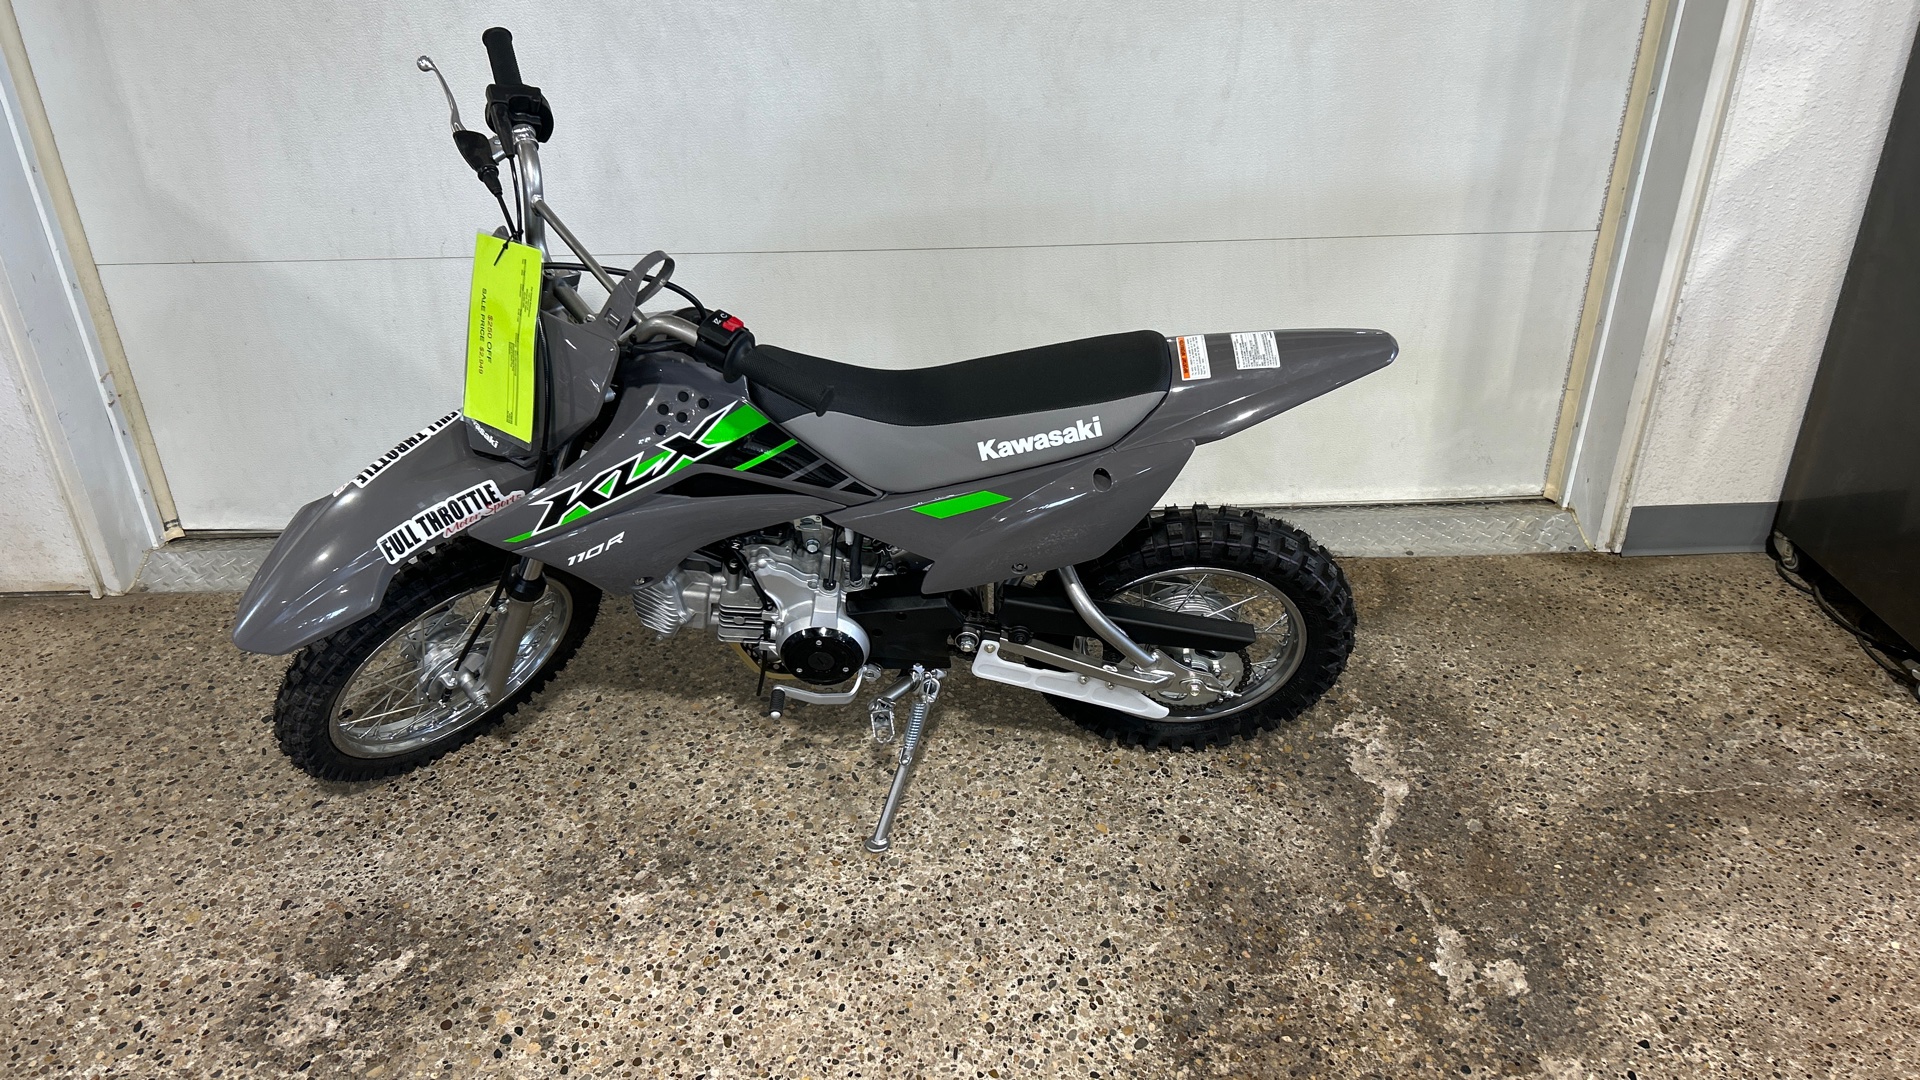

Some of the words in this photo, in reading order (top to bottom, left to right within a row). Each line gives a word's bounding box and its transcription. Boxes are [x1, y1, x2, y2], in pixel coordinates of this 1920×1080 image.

[480, 288, 488, 312] SALE
[976, 415, 1103, 462] Kawasaki
[528, 400, 739, 537] KLX
[379, 523, 422, 562] FULL
[416, 483, 501, 538] THROTTLE
[444, 513, 480, 537] Motor
[484, 493, 522, 515] Sports
[567, 531, 625, 567] 110R
